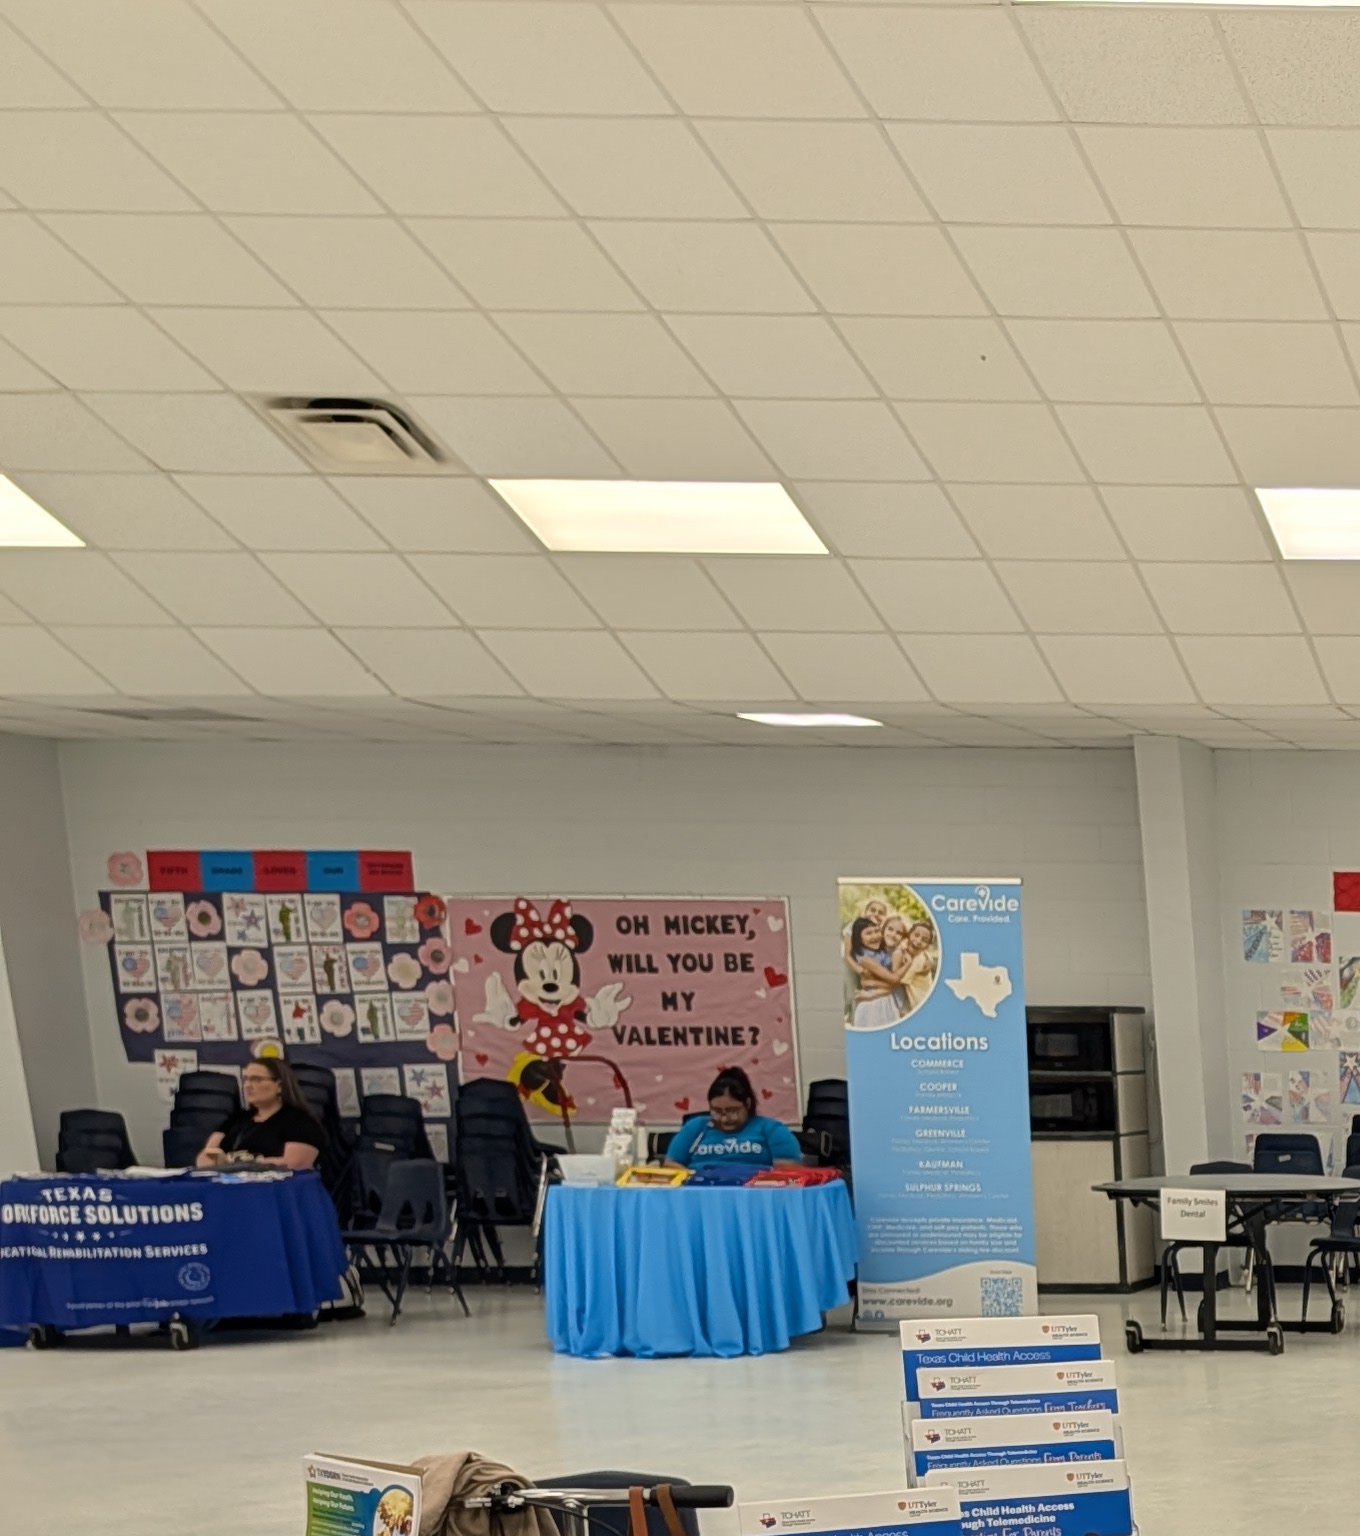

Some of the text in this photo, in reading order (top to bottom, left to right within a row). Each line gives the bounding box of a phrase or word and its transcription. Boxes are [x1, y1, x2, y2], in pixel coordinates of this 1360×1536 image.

[616, 915, 756, 940] OH MICKEY,
[608, 953, 755, 973] WILL YOU BE
[661, 991, 695, 1011] MY
[612, 1026, 760, 1046] VALENTINE?
[890, 1032, 989, 1050] Locations
[911, 1059, 964, 1069] COMMERCE
[919, 1083, 958, 1092] COOPER
[908, 1106, 970, 1115] FARMERSVILLE
[915, 1129, 966, 1138] GREENVILLE
[919, 1160, 964, 1169] KAUFMAN
[41, 1186, 113, 1202] TEXAS
[905, 1183, 982, 1192] SULPHUR SPRINGS
[1167, 1197, 1218, 1206] Family Smiles
[0, 1202, 204, 1225] ORKFORCE SOLUTIONS
[1181, 1210, 1205, 1218] Dental
[916, 1350, 1051, 1364] Texas Child Health Access
[971, 1503, 1075, 1518] Child Health Access
[986, 1515, 1056, 1527] Telemedicine
